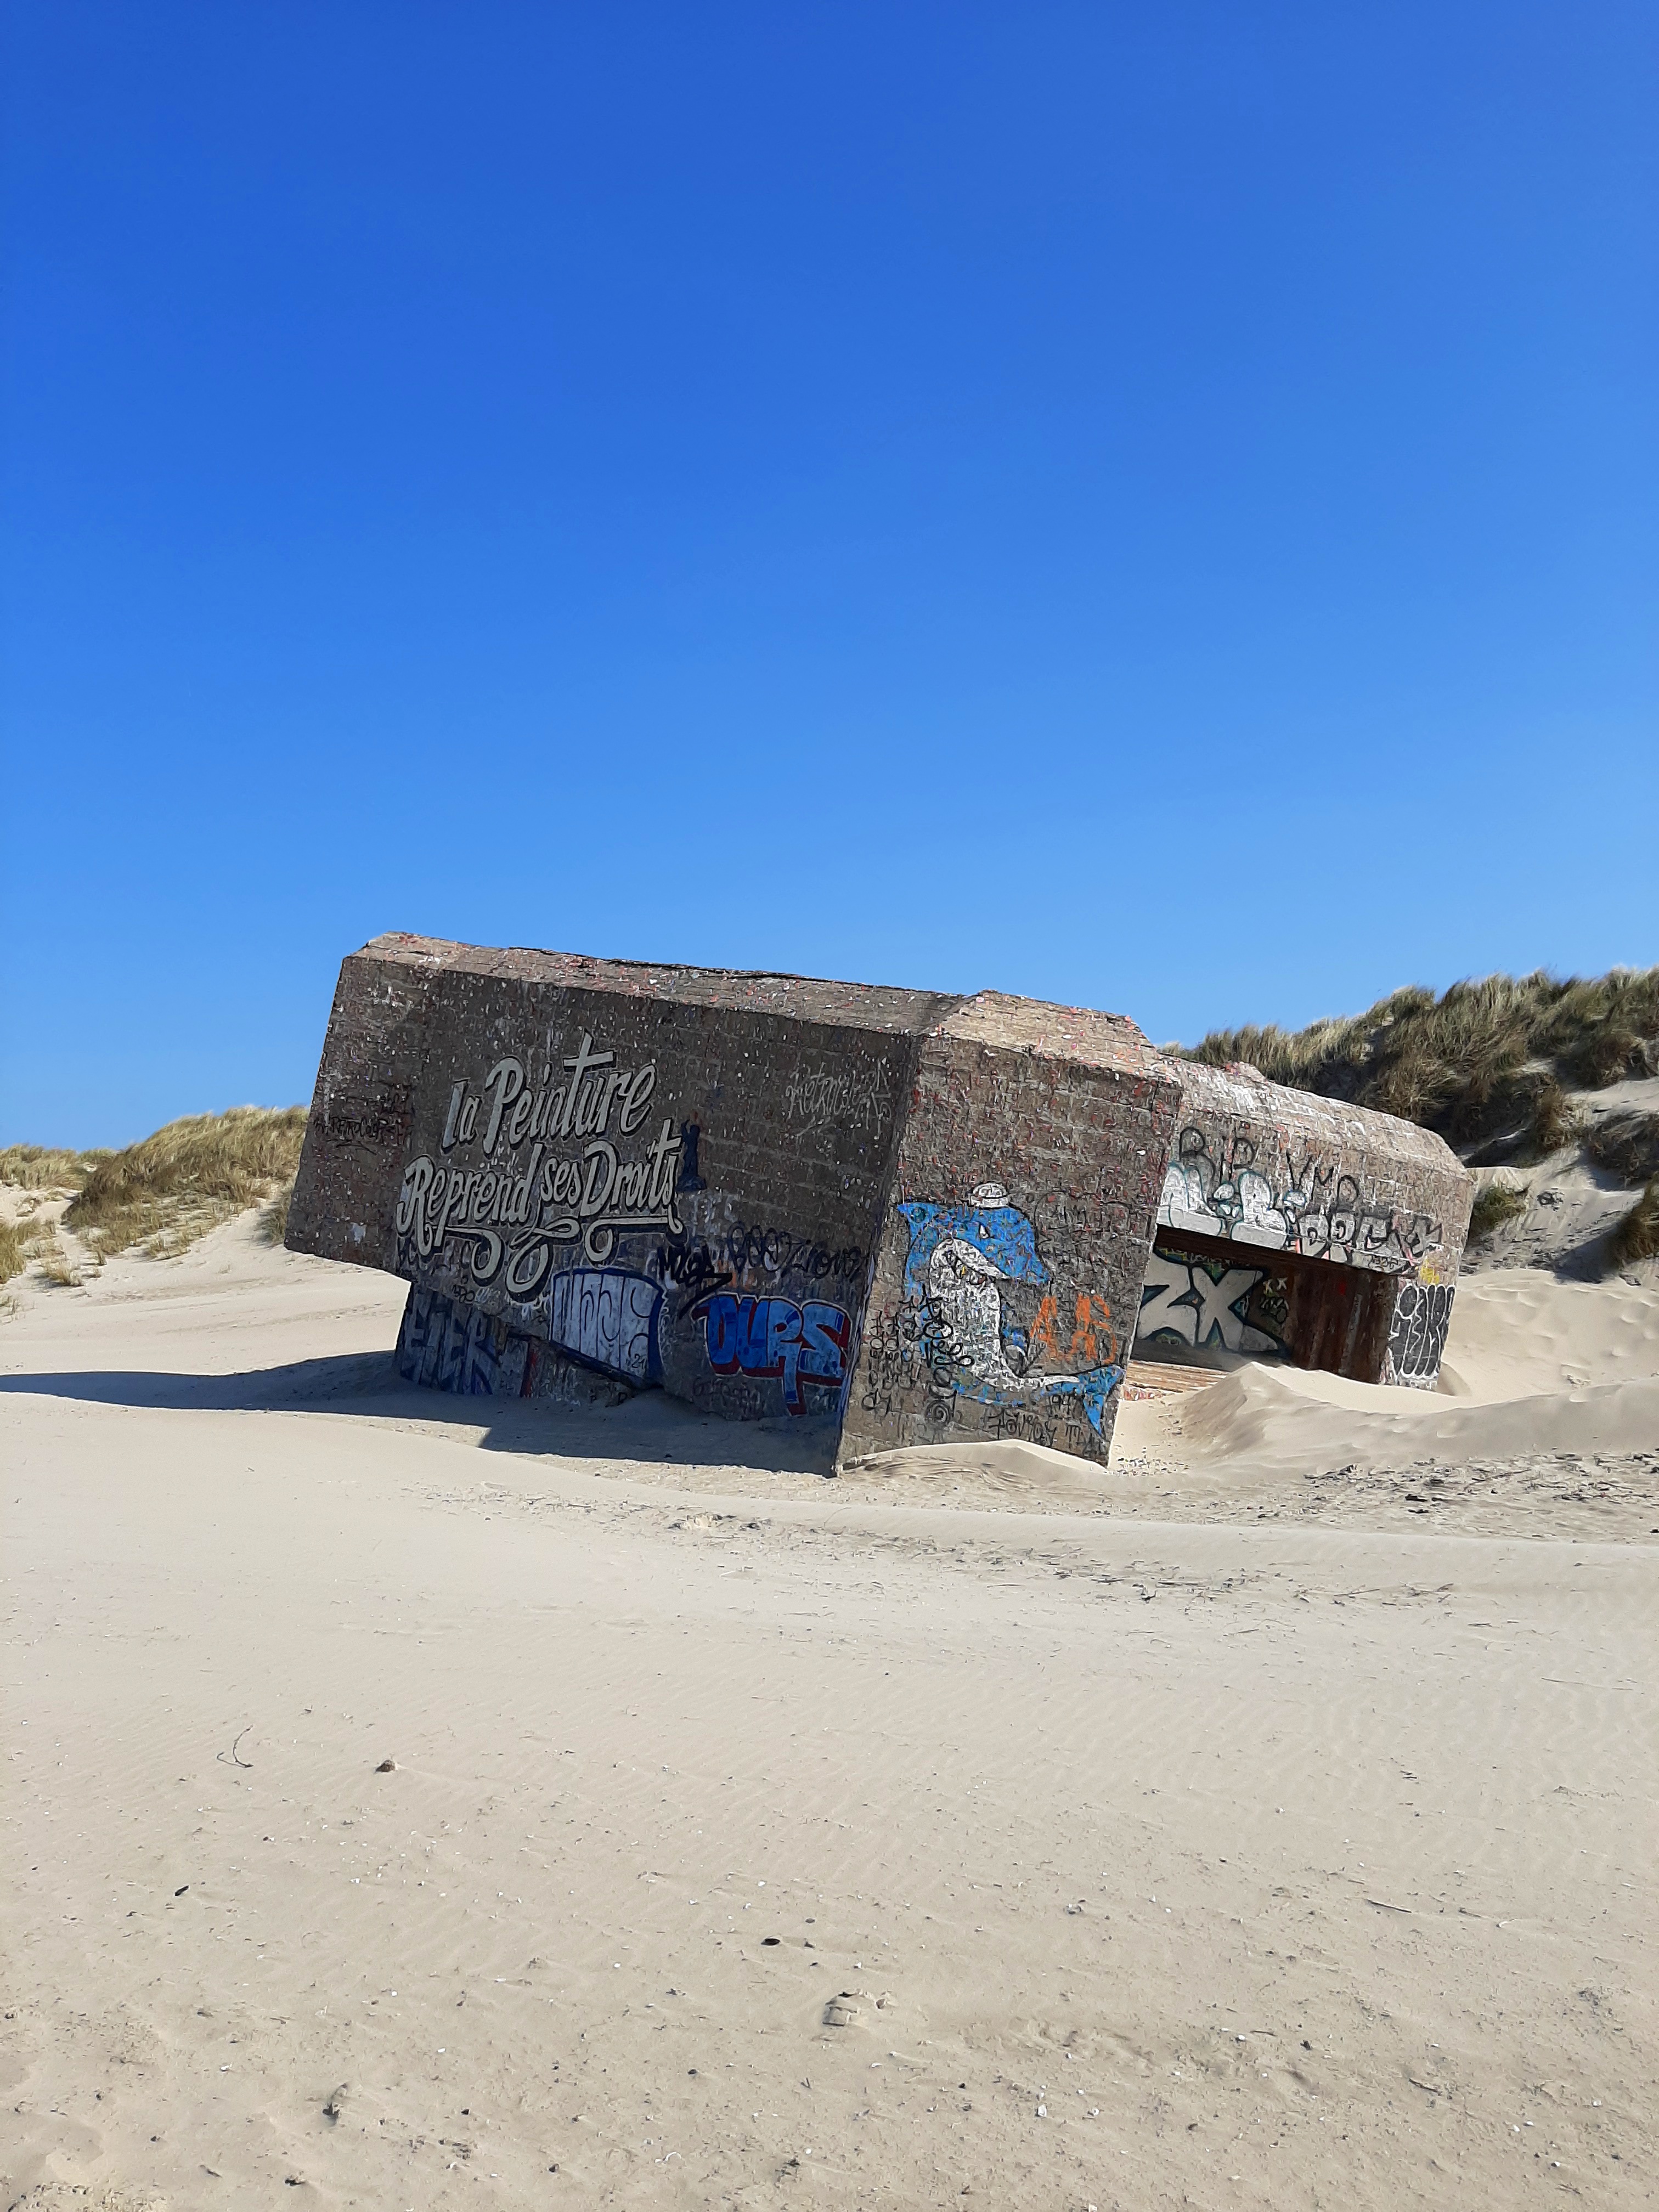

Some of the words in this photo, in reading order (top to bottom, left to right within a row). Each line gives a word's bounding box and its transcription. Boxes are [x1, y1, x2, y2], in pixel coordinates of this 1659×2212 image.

[483, 1029, 657, 1158] Peinture
[396, 1142, 546, 1265] Reprend
[540, 1155, 583, 1205] ses
[579, 1117, 685, 1234] Droits
